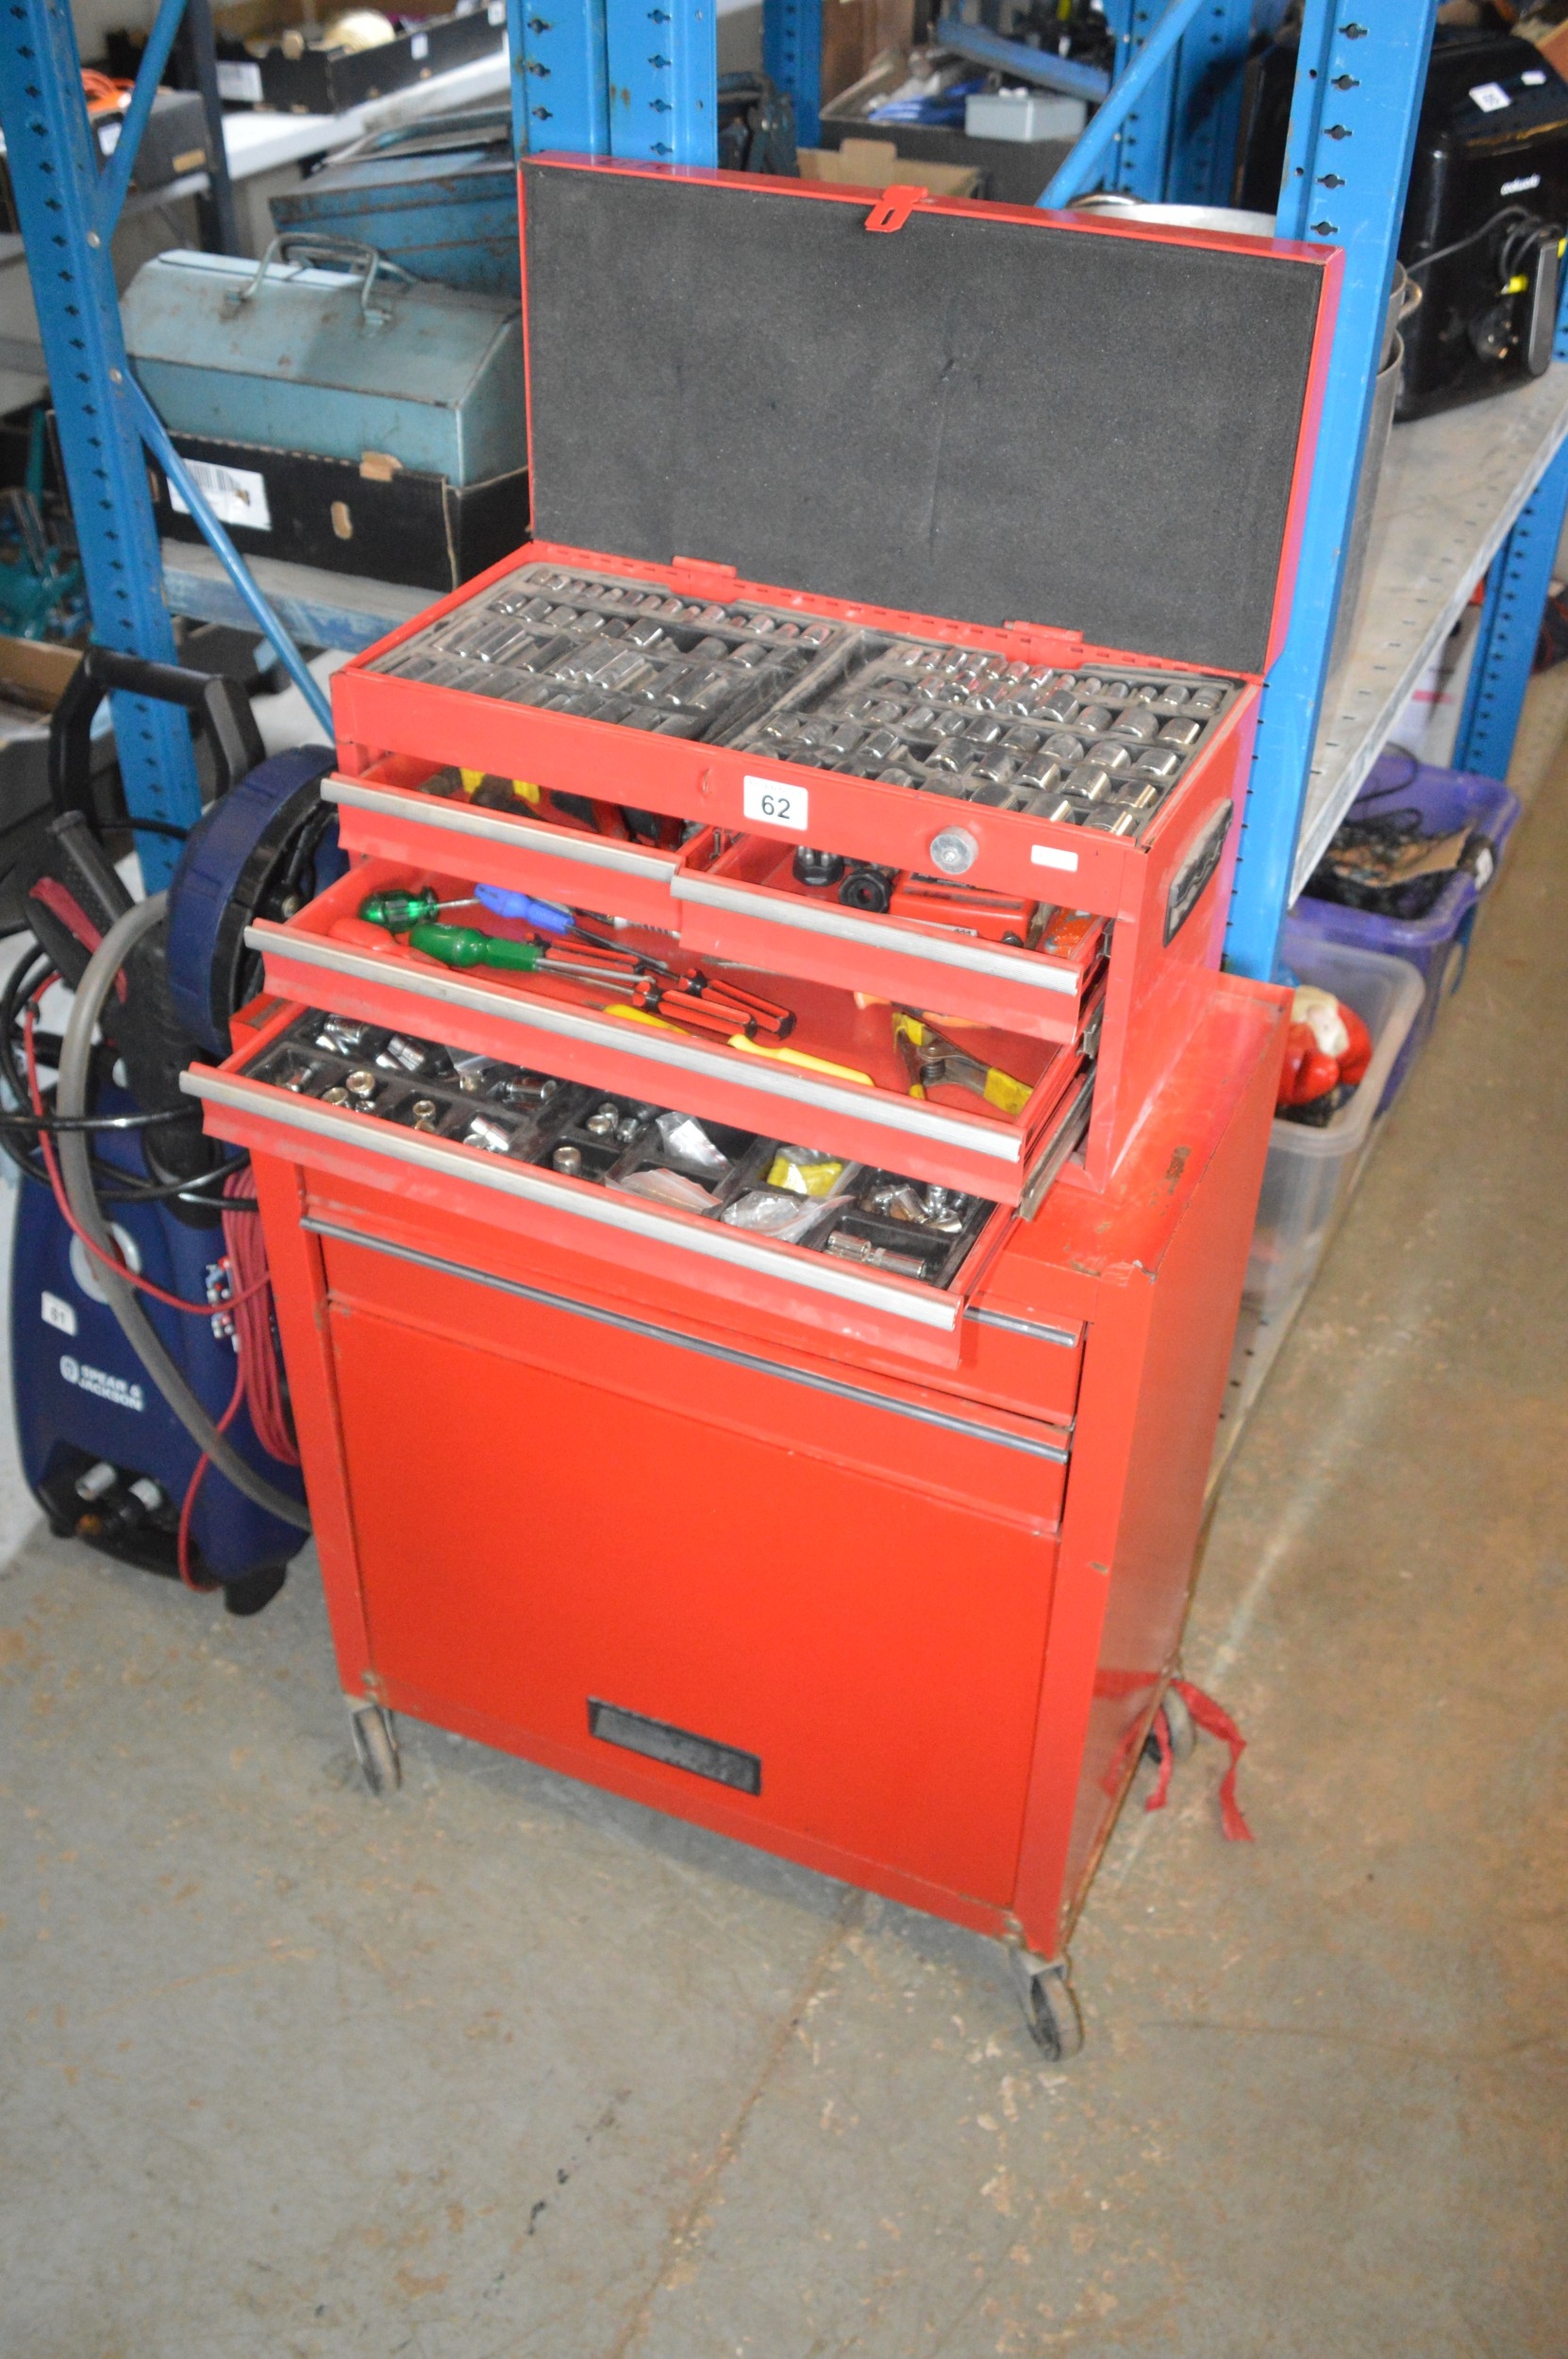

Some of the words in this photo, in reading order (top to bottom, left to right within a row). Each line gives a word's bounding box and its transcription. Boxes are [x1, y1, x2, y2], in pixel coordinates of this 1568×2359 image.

[761, 795, 790, 819] 62
[80, 1364, 127, 1394] SPEAR
[78, 1378, 143, 1412] JACKSON
